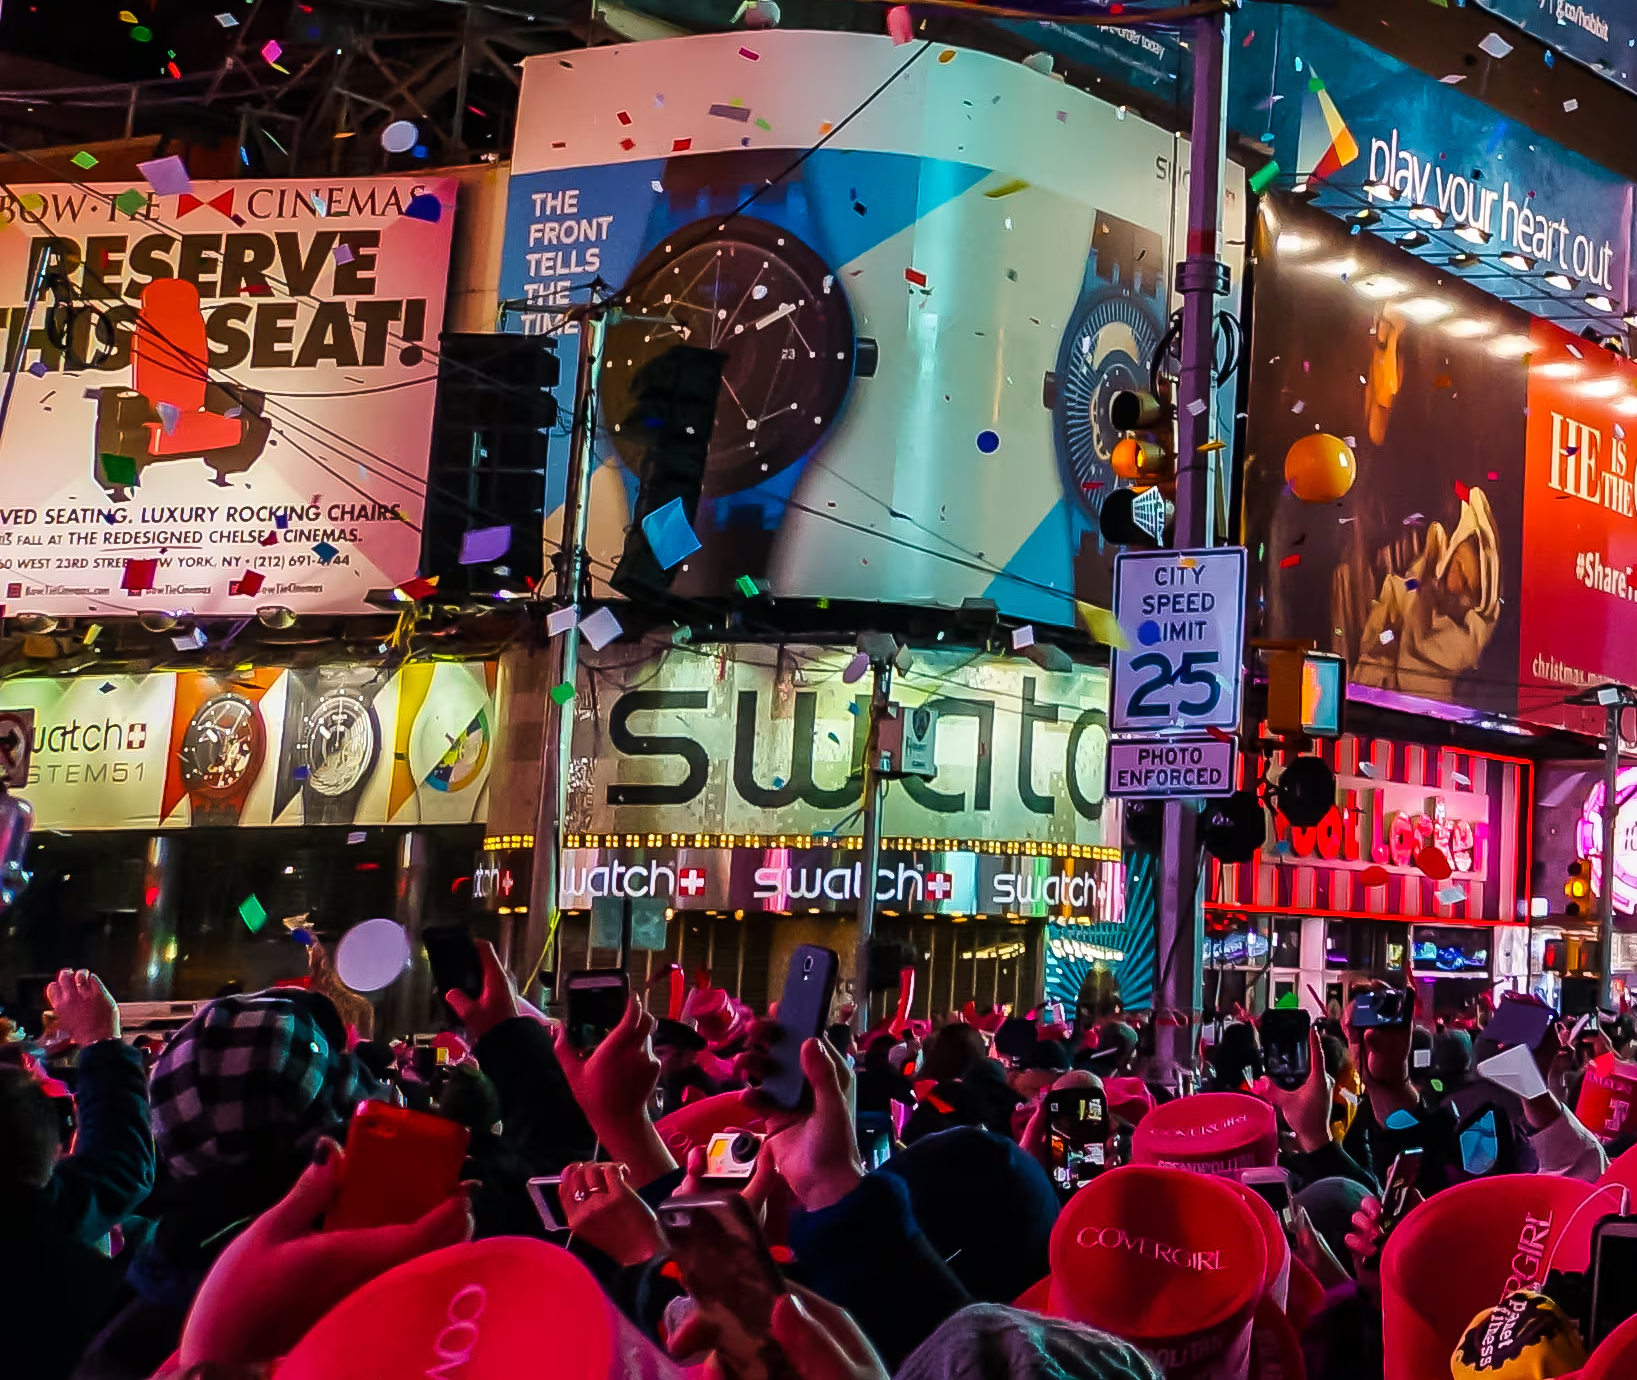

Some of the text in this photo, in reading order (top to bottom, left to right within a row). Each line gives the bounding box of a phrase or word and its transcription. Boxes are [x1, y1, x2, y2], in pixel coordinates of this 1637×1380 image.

[107, 190, 160, 221] TE
[531, 189, 580, 217] THE
[1369, 129, 1613, 291] play your heart out
[528, 215, 614, 248] FRONT
[24, 230, 380, 301] RESERVE
[525, 247, 600, 277] TELLS
[524, 280, 571, 305] THE
[206, 299, 427, 370] SEAT!
[1548, 411, 1601, 505] HE
[1612, 437, 1627, 476] IS
[1601, 470, 1633, 518] THE
[141, 506, 219, 523] LUXURY
[227, 504, 321, 523] ROCKING
[16, 528, 363, 546] FALL AT THE REDESIGNED CHELSE CINEMAS.
[17, 558, 51, 569] WEST
[56, 557, 89, 568] 23RD
[93, 557, 128, 569] STREE
[222, 556, 242, 567] NY
[253, 555, 285, 569] (212)
[1154, 565, 1204, 587] CITY
[1141, 592, 1216, 615] SPEED
[1137, 620, 1206, 643] IMIT
[1126, 651, 1220, 718] 25
[32, 718, 123, 753] watch
[606, 676, 1109, 819] swatc
[1137, 745, 1203, 767] PHOTO
[1117, 766, 1222, 787] ENFORCED
[561, 860, 675, 897] watch
[754, 861, 923, 901] swach
[993, 867, 1098, 907] swatch
[1076, 1226, 1227, 1272] COVERGIRL
